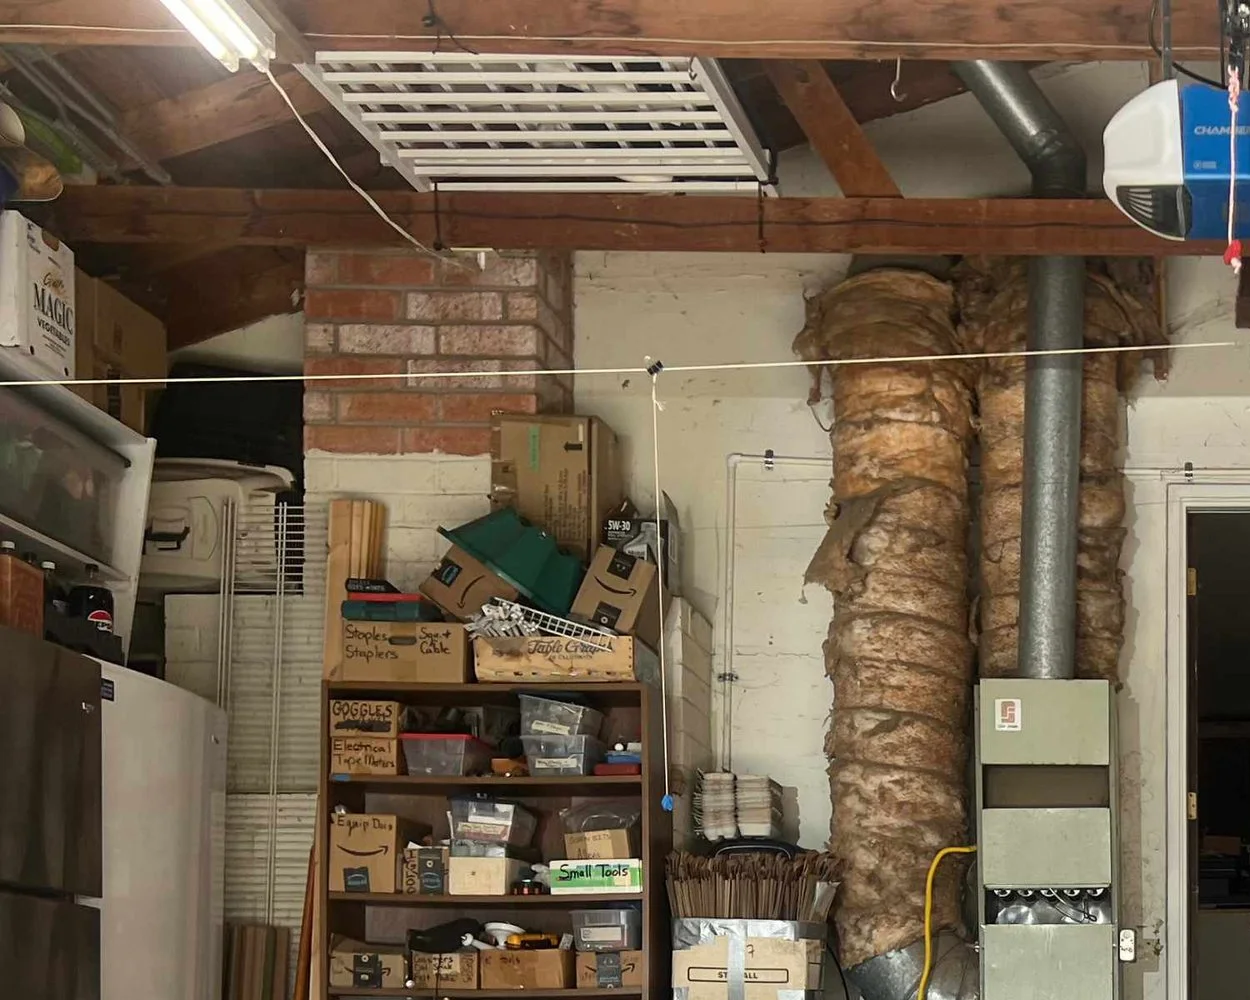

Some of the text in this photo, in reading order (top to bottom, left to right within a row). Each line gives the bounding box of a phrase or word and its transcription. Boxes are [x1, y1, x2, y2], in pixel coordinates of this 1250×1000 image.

[33, 282, 74, 335] MAGIC
[607, 519, 631, 532] 5W-30
[345, 624, 388, 645] Staples
[345, 645, 399, 664] Staplers
[332, 701, 393, 718] GOGGLES
[333, 739, 392, 754] Electrical
[336, 814, 369, 836] Equip
[559, 863, 629, 880] Small Tools
[717, 971, 758, 980] STALL
